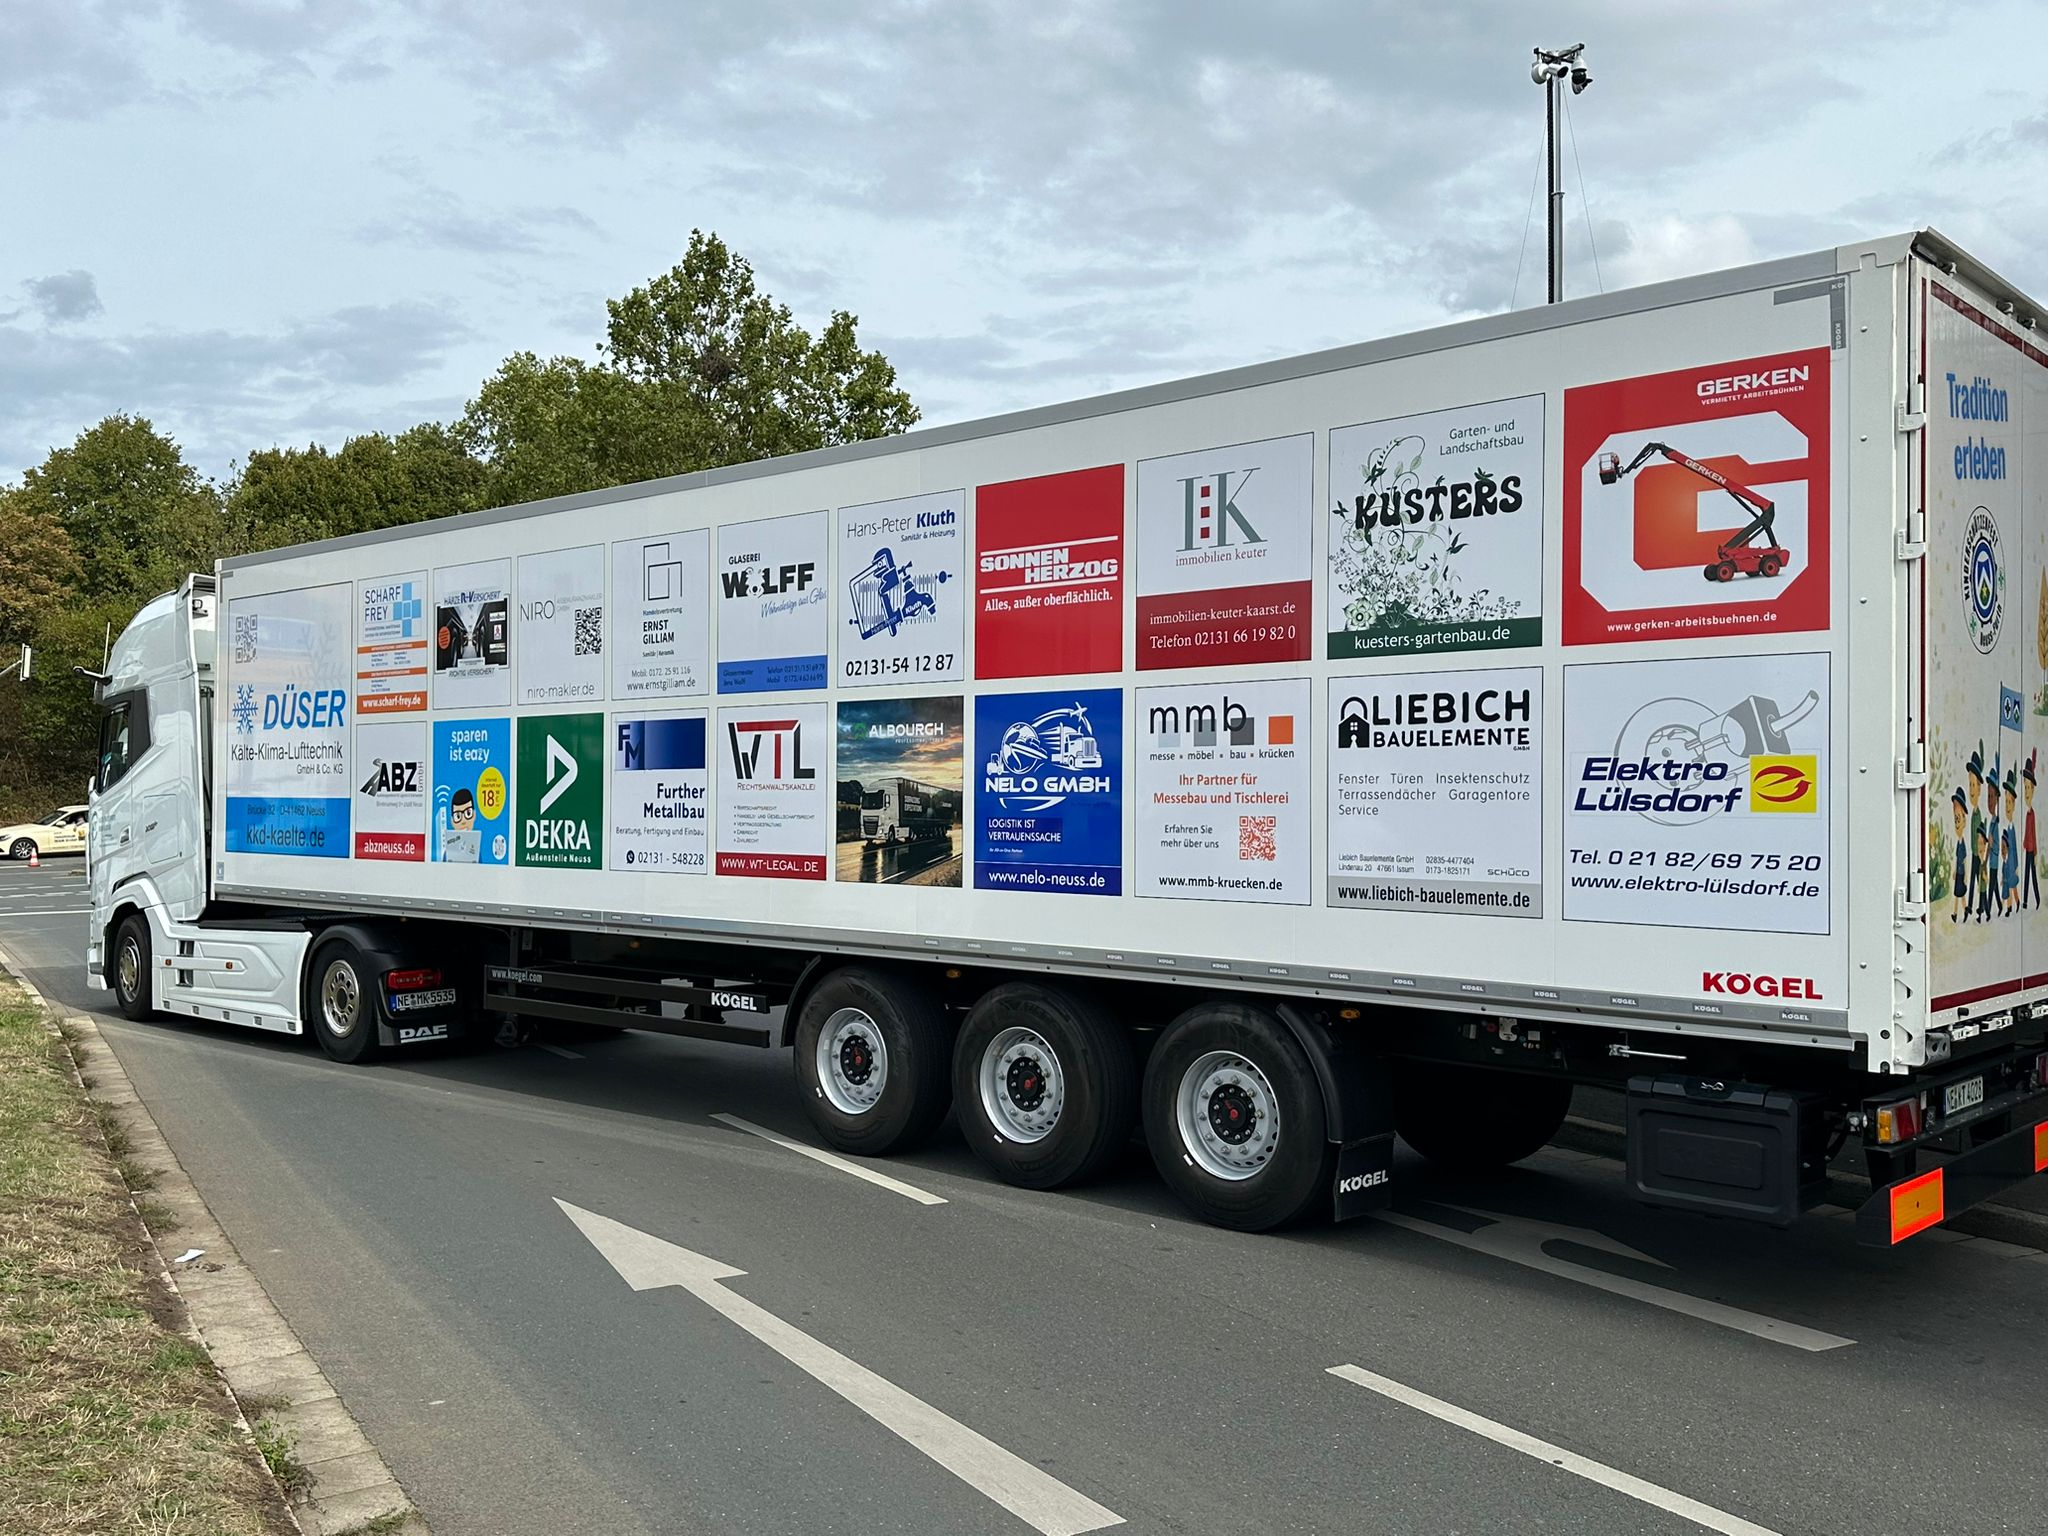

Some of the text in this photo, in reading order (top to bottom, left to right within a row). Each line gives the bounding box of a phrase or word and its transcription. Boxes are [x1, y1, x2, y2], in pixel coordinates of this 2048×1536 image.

[1697, 365, 1808, 397] GERKEN
[1701, 386, 1804, 406] VERMIETET ARBEITSBÜHNEN
[1946, 373, 2008, 422] Tradition
[1450, 420, 1514, 440] Garten- und
[1440, 436, 1524, 455] Landschaftsbau
[1954, 437, 2006, 480] erleben
[1684, 458, 1727, 484] GERKEN
[847, 510, 955, 538] Hans-Peter Kluth
[901, 532, 921, 542] Sanitär
[930, 529, 955, 538] Heizung
[729, 553, 760, 565] GLASEREI
[980, 548, 1069, 572] SONNEN
[1176, 548, 1267, 566] immobilien keuter
[1025, 559, 1118, 583] HERZOG
[365, 586, 401, 604] SCHARF
[985, 588, 1113, 612] Alles, außer oberflächlich.
[365, 606, 388, 621] FREY
[520, 600, 555, 622] NIRO
[1150, 602, 1296, 625] immobilien-keuter-kaarst.de
[643, 620, 668, 632] ERNST
[1607, 612, 1777, 633] www.gerken-arbeitsbuehnen.de
[643, 632, 674, 644] GILLIAM
[1150, 626, 1295, 649] Telefon 02131 66 19 82 0
[1355, 626, 1510, 649] kuesters-gartenbau.de
[846, 654, 953, 676] 02131-54 12 87
[528, 683, 594, 699] niro-makler.de
[627, 678, 695, 691] www.ernstgilliam.de
[263, 684, 346, 729] DÜSER
[363, 695, 420, 707] www.scharf-frey.de
[1373, 689, 1530, 725] LIEBICH
[1150, 696, 1246, 734] mmb
[452, 729, 487, 745] sparen
[869, 722, 944, 738] ALBOURGH
[1374, 728, 1530, 747] BAUELEMENTE
[232, 741, 343, 761] Kälte-Klima-Lufttechnik
[450, 746, 489, 763] ist eazy
[728, 720, 815, 779] WTL
[1150, 749, 1294, 761] messe möbel bau krücken
[297, 764, 343, 774] GmbH & Co. KG
[377, 762, 417, 792] ABZ
[1582, 757, 1729, 781] Elektro
[986, 777, 1109, 792] NELO GMBH
[1179, 773, 1257, 785] Ihr Partner für
[1339, 772, 1530, 785] Fenster Türen Insektenschutz
[482, 790, 494, 807] 18
[657, 783, 705, 799] Further
[1154, 792, 1288, 803] Messebau und Tischlerei
[1339, 788, 1530, 803] Terrassendächer Garagentore
[1574, 787, 1743, 812] Lülsdorf
[644, 803, 704, 819] Metallbau
[1339, 804, 1379, 816] Service
[616, 827, 642, 836] Beratung,
[644, 827, 670, 837] Fertigung
[685, 828, 704, 836] Einbau
[989, 819, 1035, 829] LOGISTIK IST
[1165, 825, 1213, 834] Erfahren Sie
[246, 824, 325, 847] kkd-kaelte.de
[526, 820, 591, 850] DEKRA
[989, 831, 1061, 842] VERTRAUENSSACHE
[1161, 839, 1181, 847] mehr
[1184, 839, 1202, 848] über
[364, 840, 415, 854] abzneuss.de
[526, 853, 591, 863] Außenstelle Neuss
[638, 852, 663, 863] 02131
[672, 853, 704, 865] 548228
[722, 858, 818, 872] WWW.WT-LEGAL.DE
[1396, 855, 1414, 863] GmbH
[1570, 850, 1821, 871] Tel. 0 21 82/69 75 20
[989, 870, 1105, 887] www.nelo-neuss.de
[1159, 876, 1282, 890] www.mmb-kruecken.de
[1571, 876, 1819, 897] www.elektro-lülsdorf.de
[1338, 885, 1530, 908] www.liebich-bauelemente.de
[492, 969, 542, 983] www.koegel.com
[1703, 972, 1823, 999] KÖGEL
[397, 995, 409, 1007] NE
[430, 990, 454, 1003] 5535
[711, 992, 757, 1011] KÖGEL
[400, 1024, 447, 1038] DAF
[1340, 1169, 1388, 1193] KÖGEL
